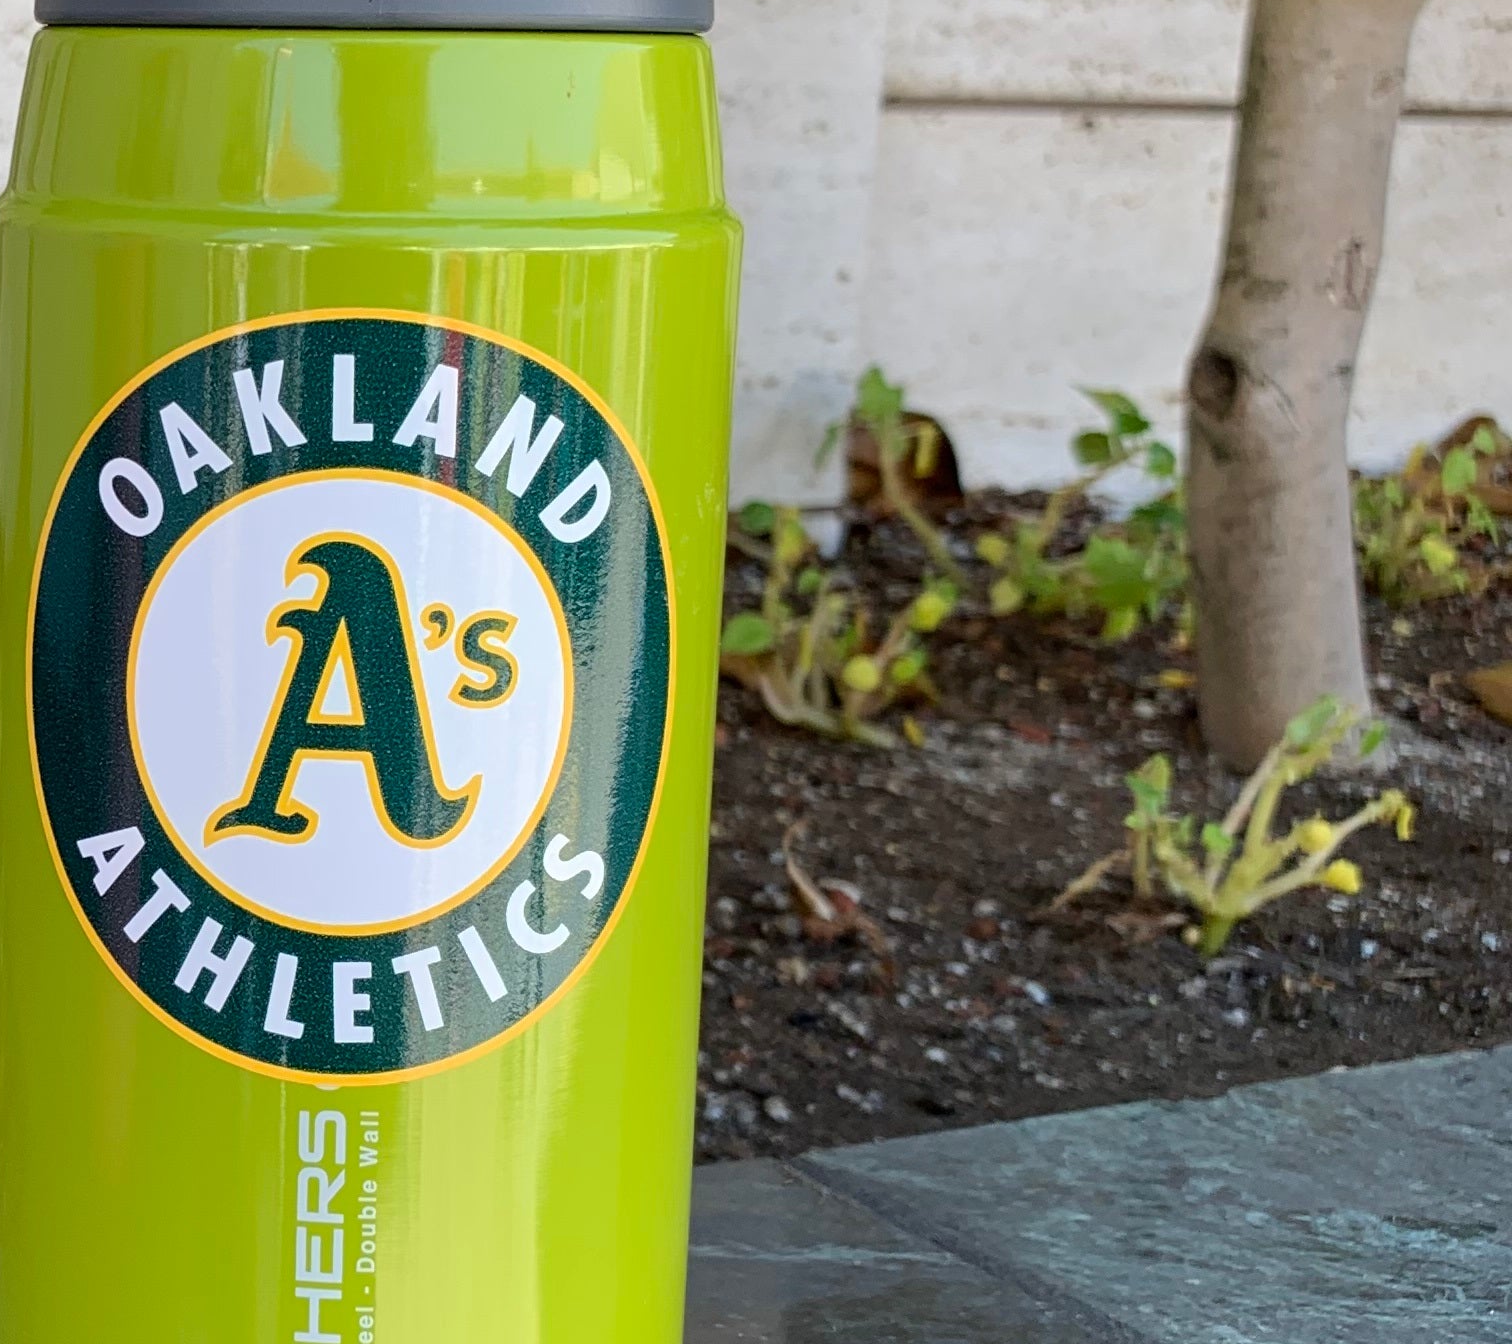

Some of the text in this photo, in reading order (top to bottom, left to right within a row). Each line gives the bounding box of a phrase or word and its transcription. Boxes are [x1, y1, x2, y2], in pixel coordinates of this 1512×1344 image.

[98, 353, 612, 545] OAKLAND
[76, 824, 606, 1045] ATHLETICS
[359, 1110, 380, 1167] Wall
[356, 1179, 377, 1273] Double
